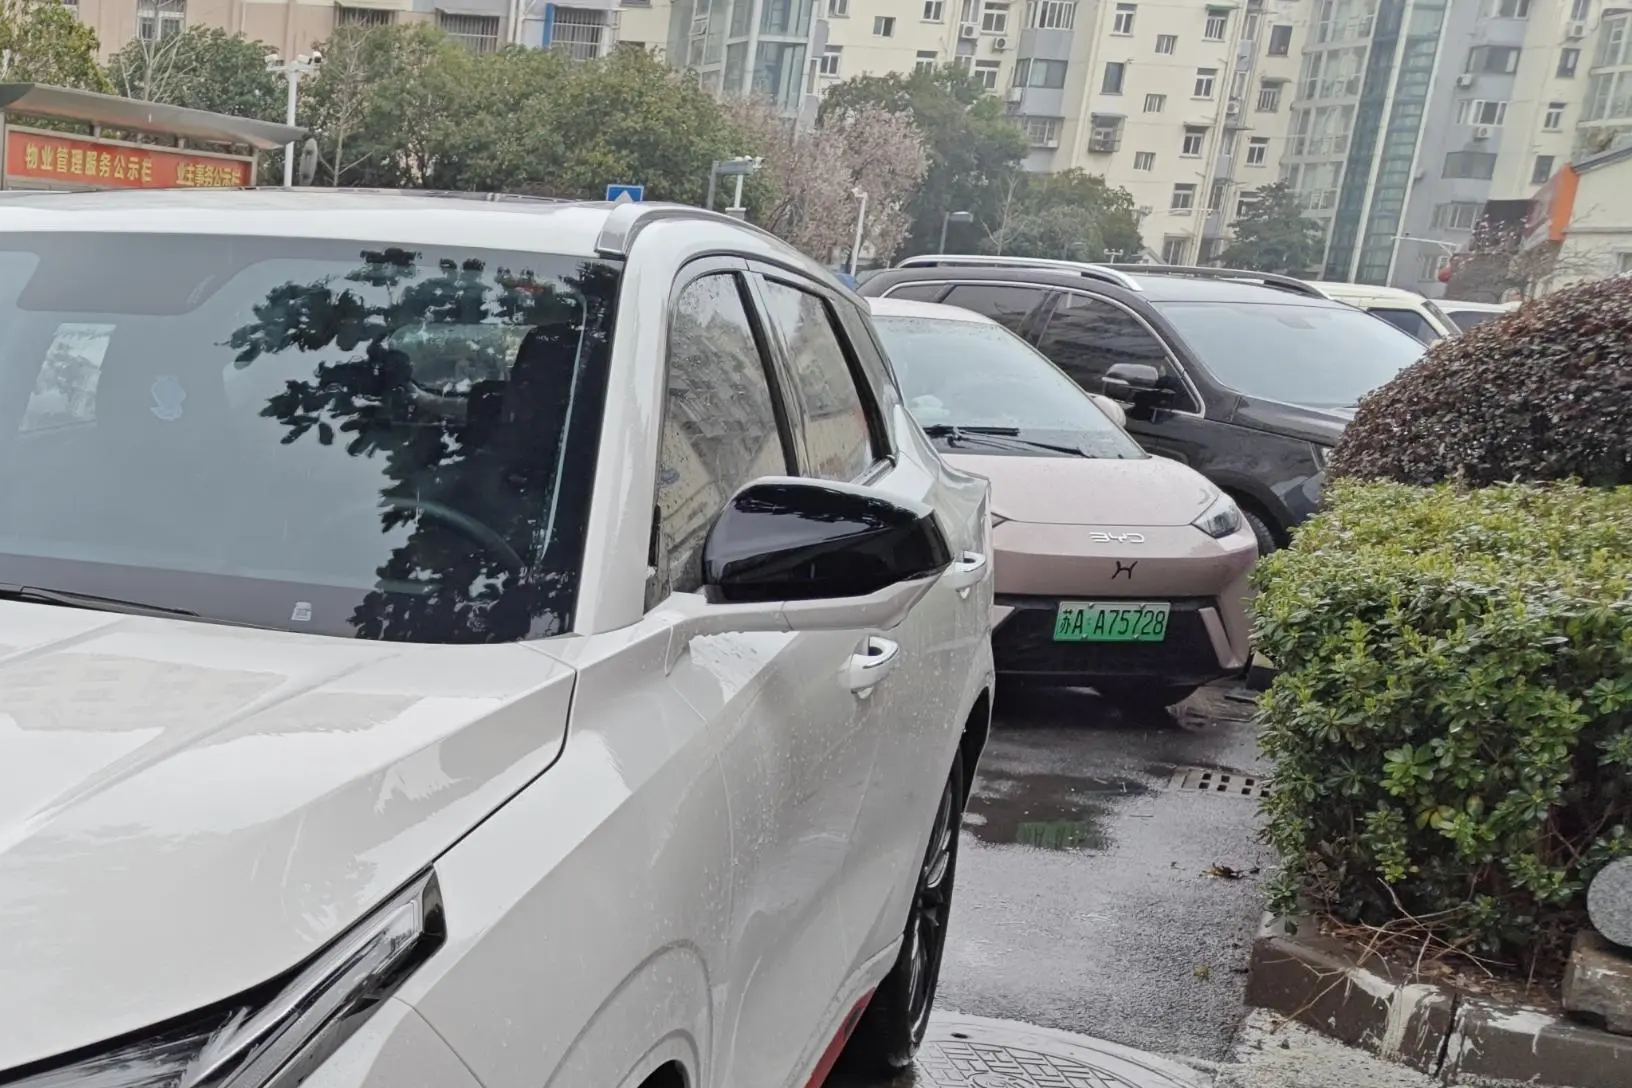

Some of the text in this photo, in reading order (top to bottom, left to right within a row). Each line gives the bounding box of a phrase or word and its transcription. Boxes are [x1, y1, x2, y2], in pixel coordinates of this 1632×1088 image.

[25, 142, 243, 187] 物业管理服务公示栏 业主事务公示栏
[1088, 531, 1145, 544] BYD
